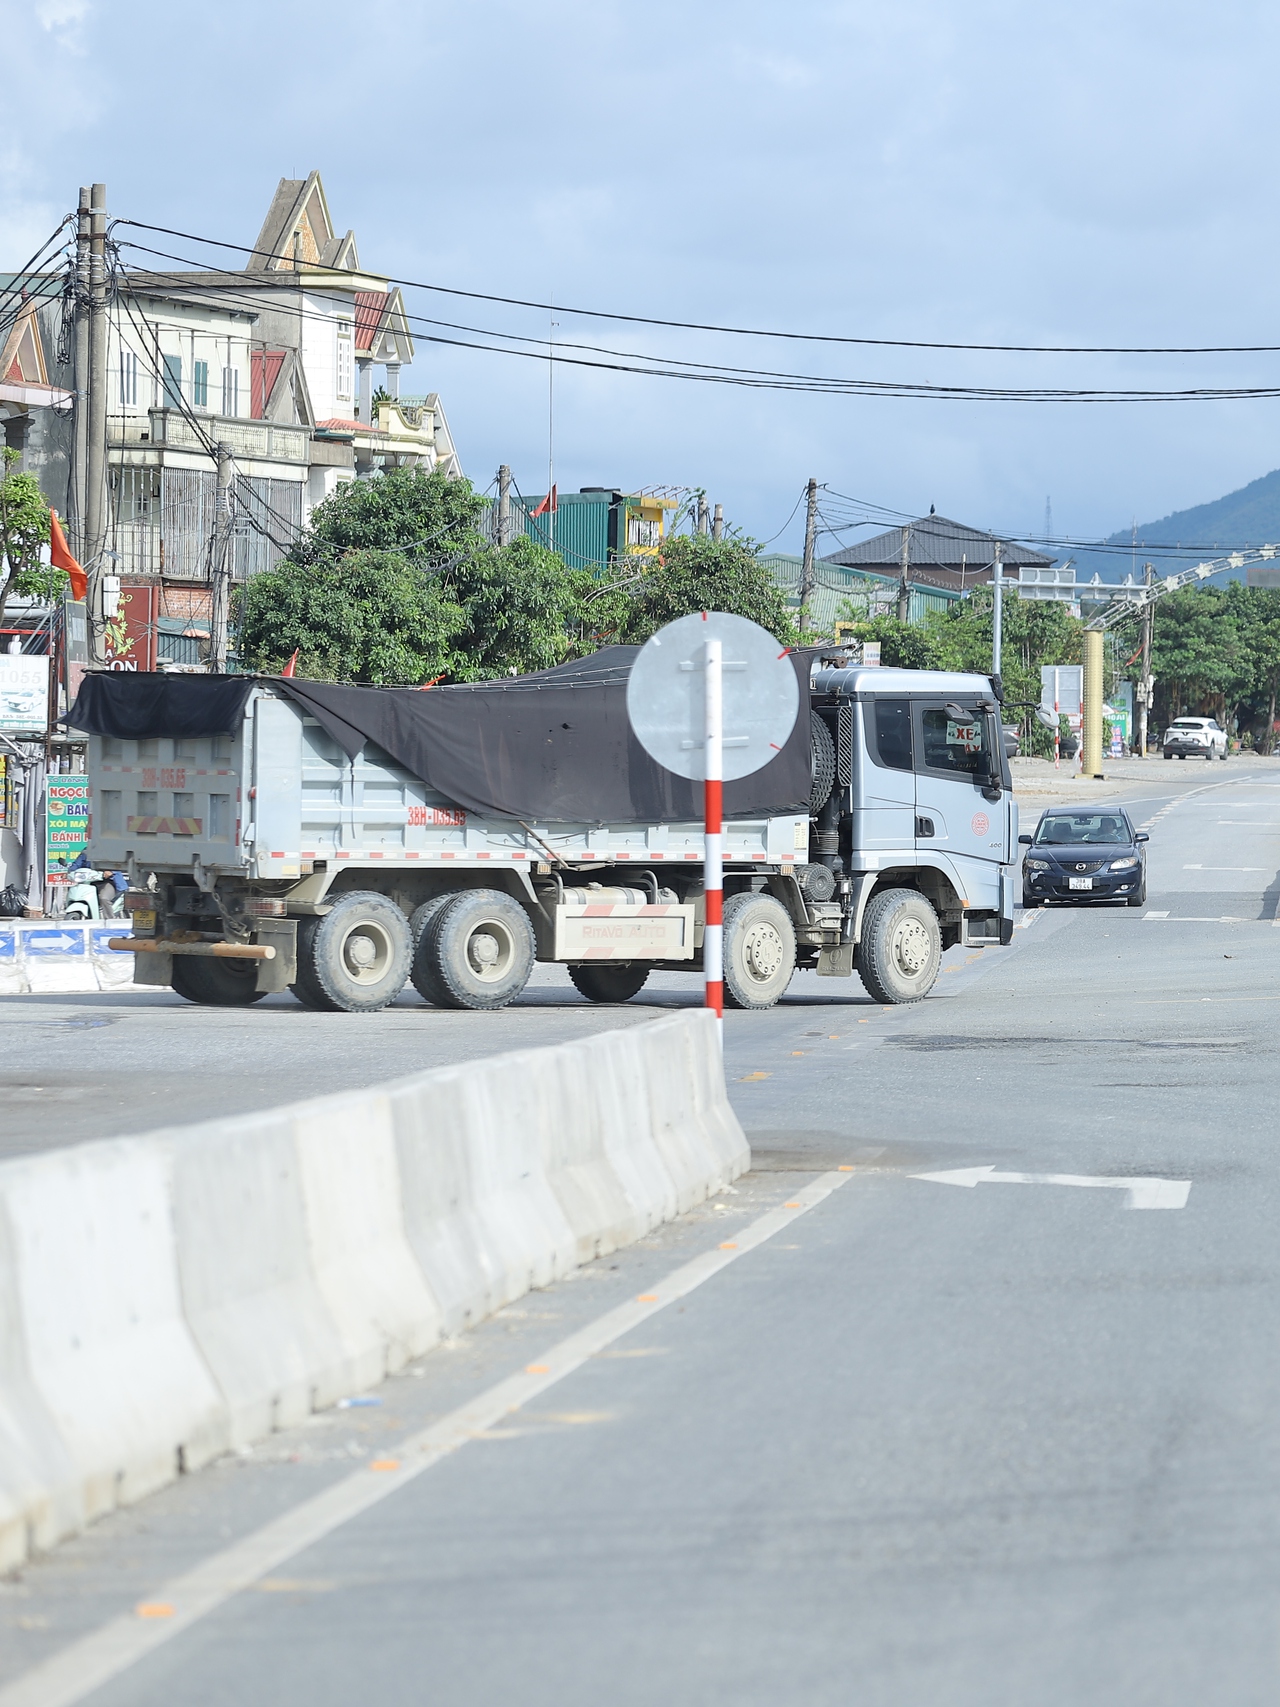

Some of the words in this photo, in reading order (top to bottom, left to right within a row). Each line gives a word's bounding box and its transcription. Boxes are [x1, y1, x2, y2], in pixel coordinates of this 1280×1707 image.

[956, 728, 974, 740] XE
[50, 787, 83, 800] NGỌC
[408, 806, 466, 826] 38H-035.65
[49, 819, 67, 828] XÔI
[52, 830, 81, 841] BÁNH
[629, 926, 667, 938] AUTO
